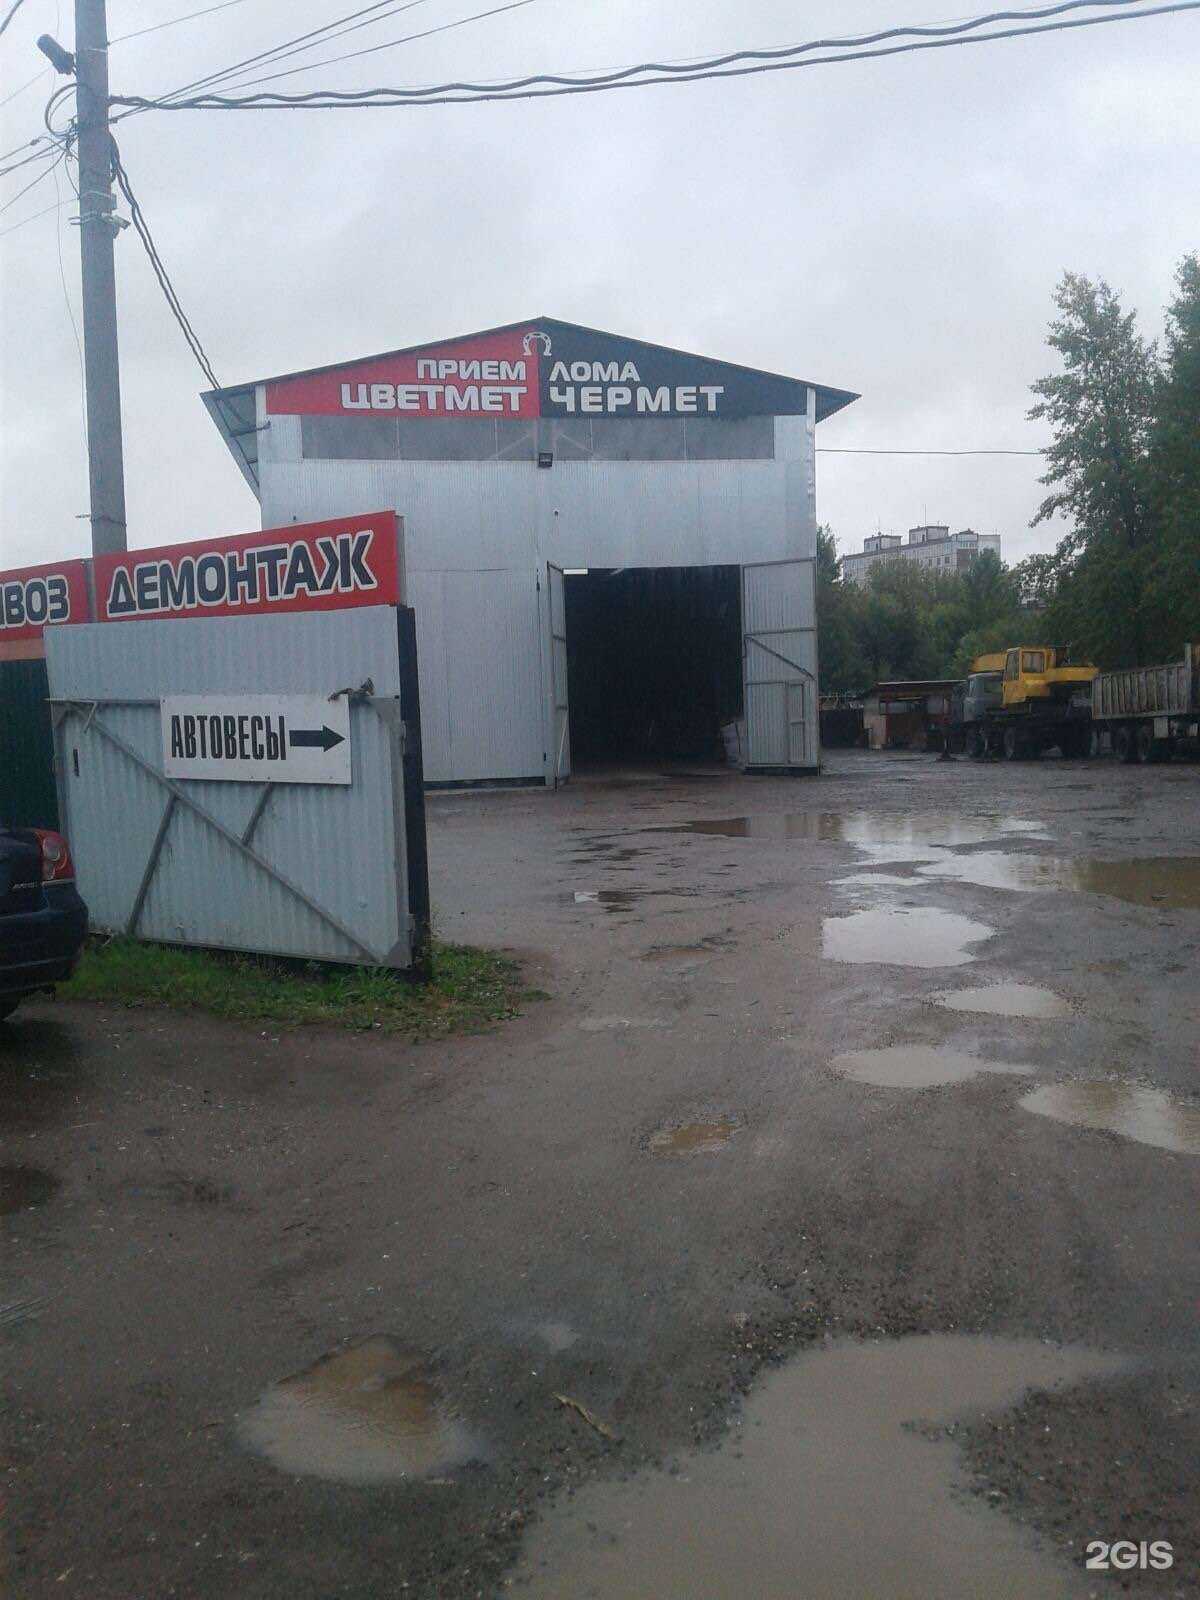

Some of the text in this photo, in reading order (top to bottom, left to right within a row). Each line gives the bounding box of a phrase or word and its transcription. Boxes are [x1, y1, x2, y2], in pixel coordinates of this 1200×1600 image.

[416, 359, 640, 382] ПРИЕМ ЛОМА
[340, 383, 724, 413] ЦВЕТМЕТ ЧЕРМЕТ
[107, 531, 377, 617] ДЕМОНТАЖ
[0, 574, 70, 629] ВОЗ
[171, 715, 287, 761] АВТОВЕСЫ
